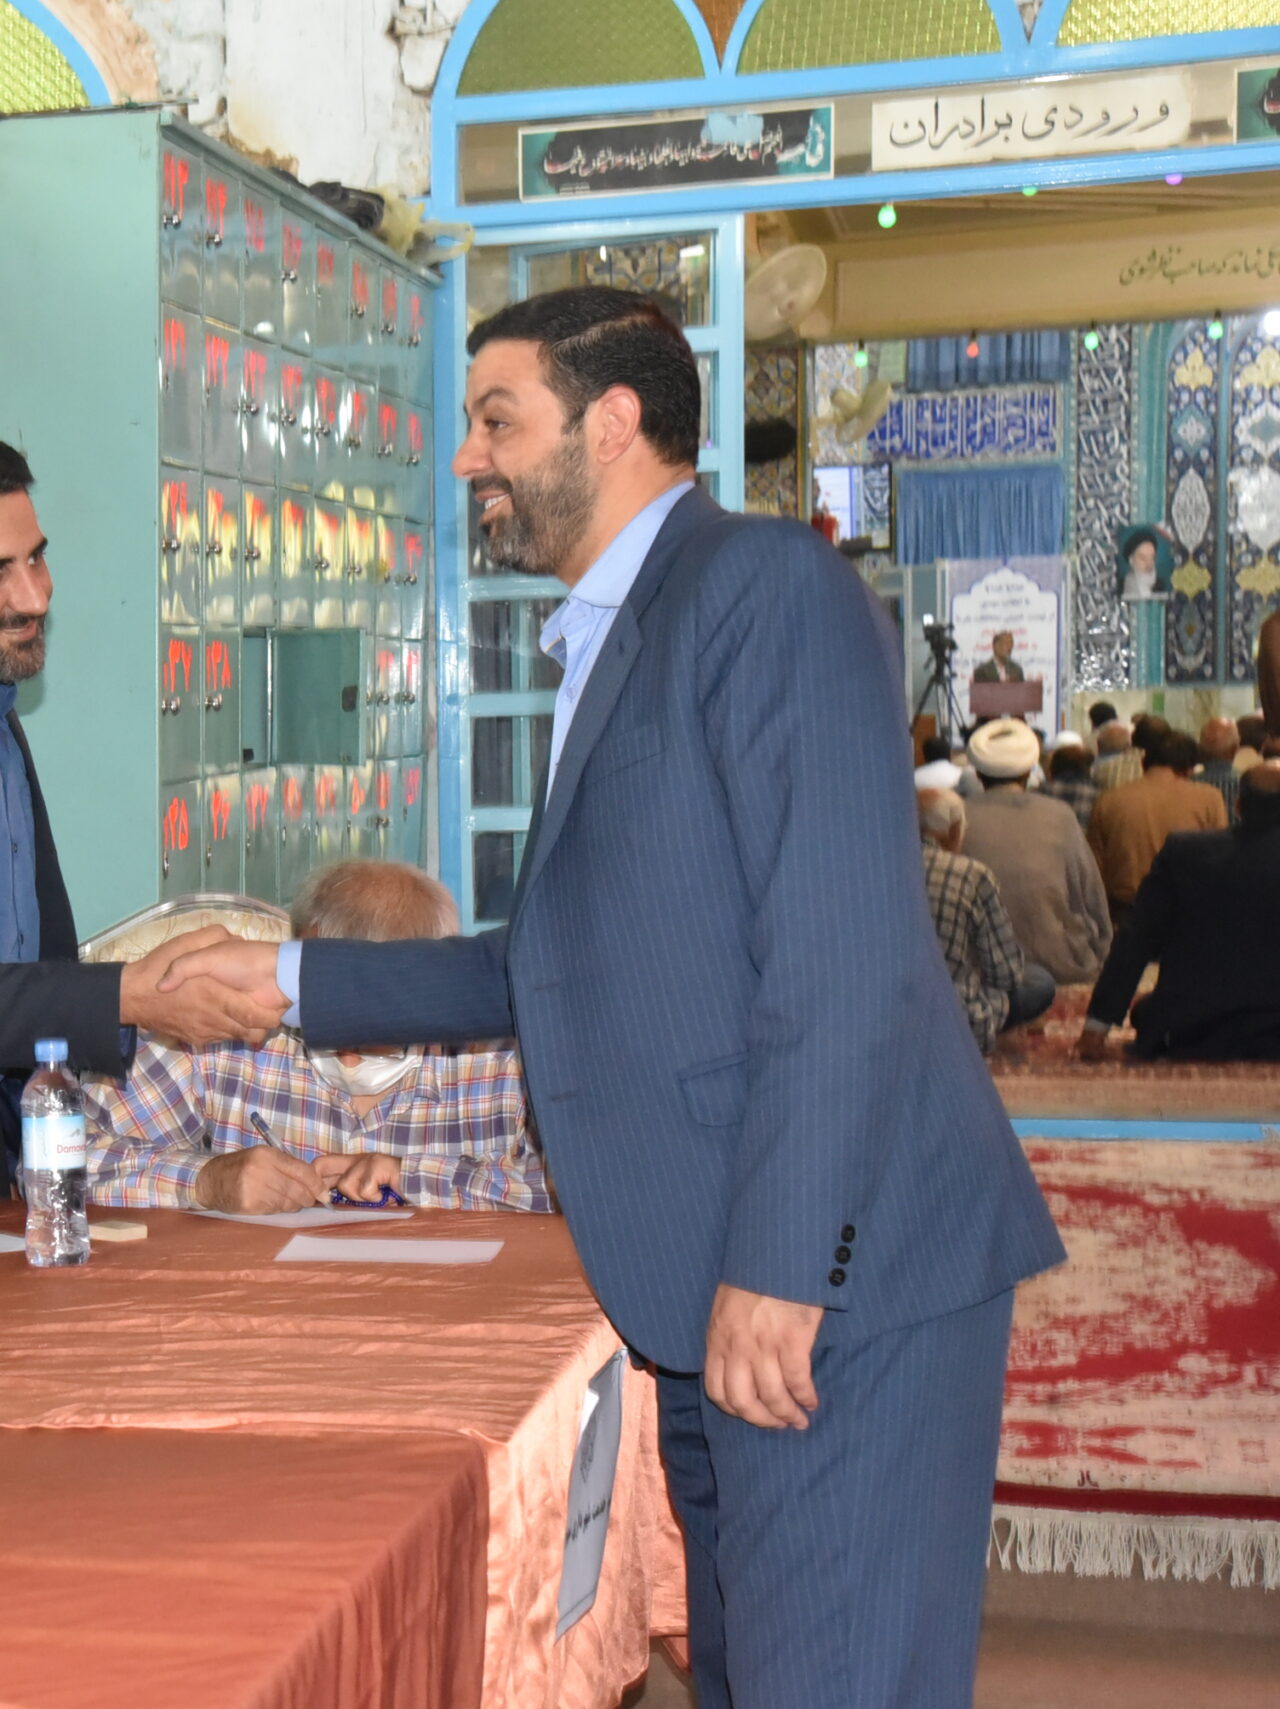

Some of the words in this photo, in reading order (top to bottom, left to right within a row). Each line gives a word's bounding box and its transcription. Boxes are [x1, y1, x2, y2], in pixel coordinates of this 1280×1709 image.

[890, 96, 1013, 149] برادران
[1022, 100, 1170, 140] ورودی
[163, 153, 189, 218] ۱۱۳
[163, 640, 192, 693] ۱۳۷
[206, 640, 232, 691] ۱۳۸
[163, 796, 189, 851] ۱۴۵
